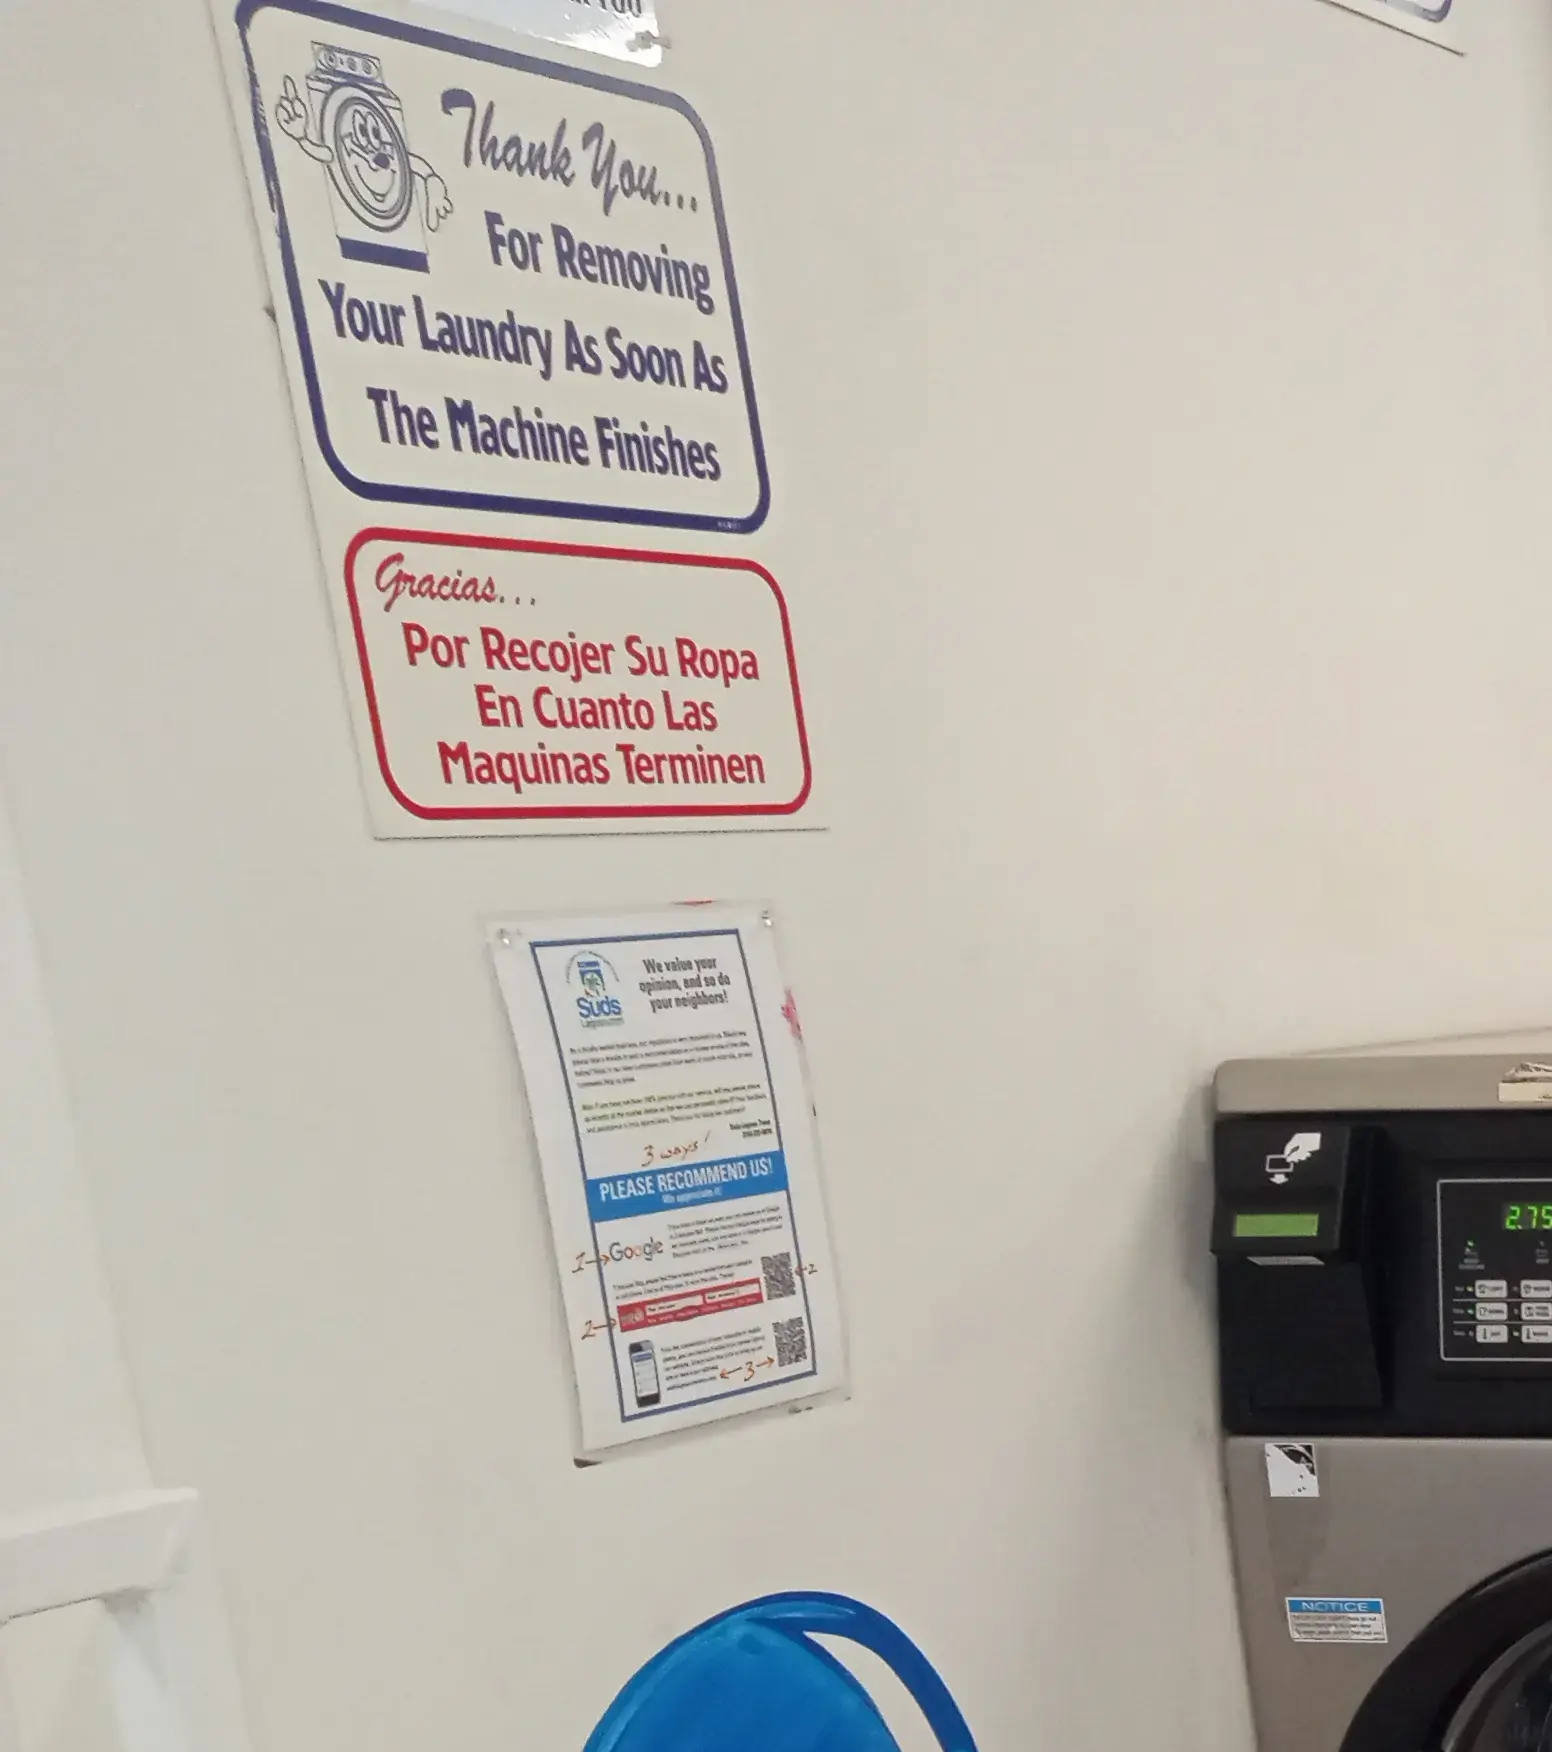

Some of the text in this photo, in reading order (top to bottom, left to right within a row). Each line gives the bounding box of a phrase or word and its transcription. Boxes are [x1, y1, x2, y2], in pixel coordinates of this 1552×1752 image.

[441, 86, 698, 216] Thank You...
[484, 210, 715, 316] For Removing
[318, 278, 729, 395] Your Laundry As Soon As
[367, 387, 722, 482] The Machine Finishes
[373, 551, 538, 613] Gracias...
[401, 621, 760, 687] Por Recojer Su Ropa
[474, 683, 717, 733] En Cuanto Las
[437, 741, 765, 795] Maquinas Terminen
[639, 971, 731, 997] opinion, and so do
[643, 957, 718, 975] We value your
[576, 995, 622, 1019] Suds
[650, 989, 729, 1014] your neighbors!
[600, 1177, 655, 1203] PLEASE
[657, 1166, 748, 1194] RECOMMEND
[750, 1156, 773, 1176] US!
[641, 1144, 654, 1168] 3
[608, 1236, 664, 1262] Google
[1301, 1601, 1369, 1612] NOTICE
